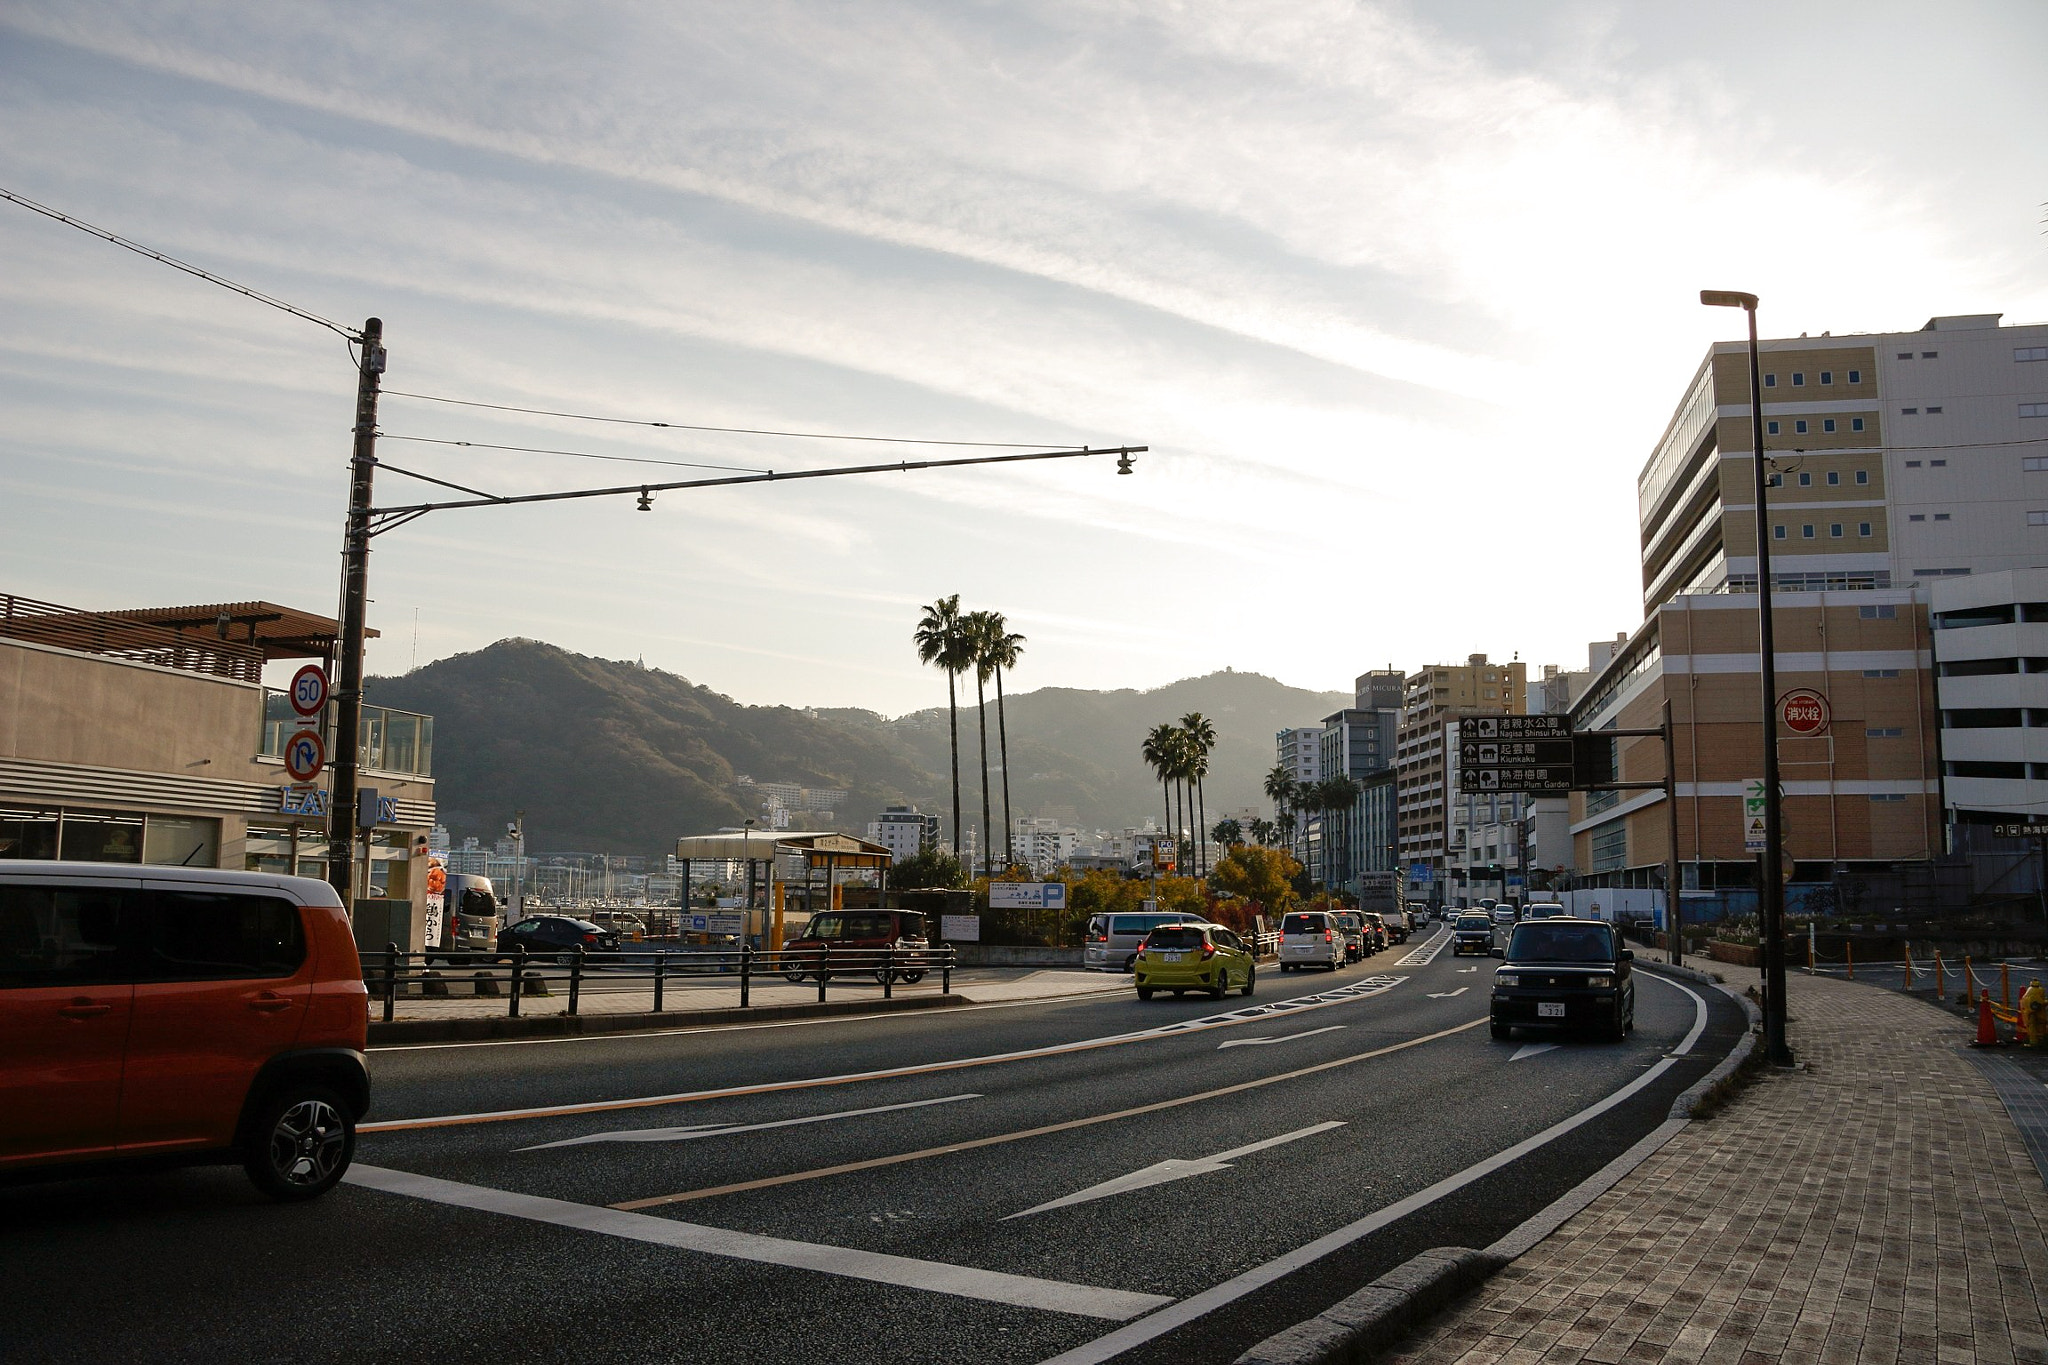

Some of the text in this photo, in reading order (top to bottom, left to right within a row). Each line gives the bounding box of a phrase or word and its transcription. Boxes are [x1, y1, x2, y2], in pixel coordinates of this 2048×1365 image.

[298, 679, 319, 702] 50
[1787, 706, 1820, 721] 消火栓
[1500, 717, 1558, 729] 渚親水公園
[1500, 728, 1568, 739] Nagisa Shinsui Park
[1500, 743, 1535, 755] 起雲閣
[1500, 768, 1548, 781] 熱海梅園
[1501, 780, 1570, 789] Atami Plum Garden
